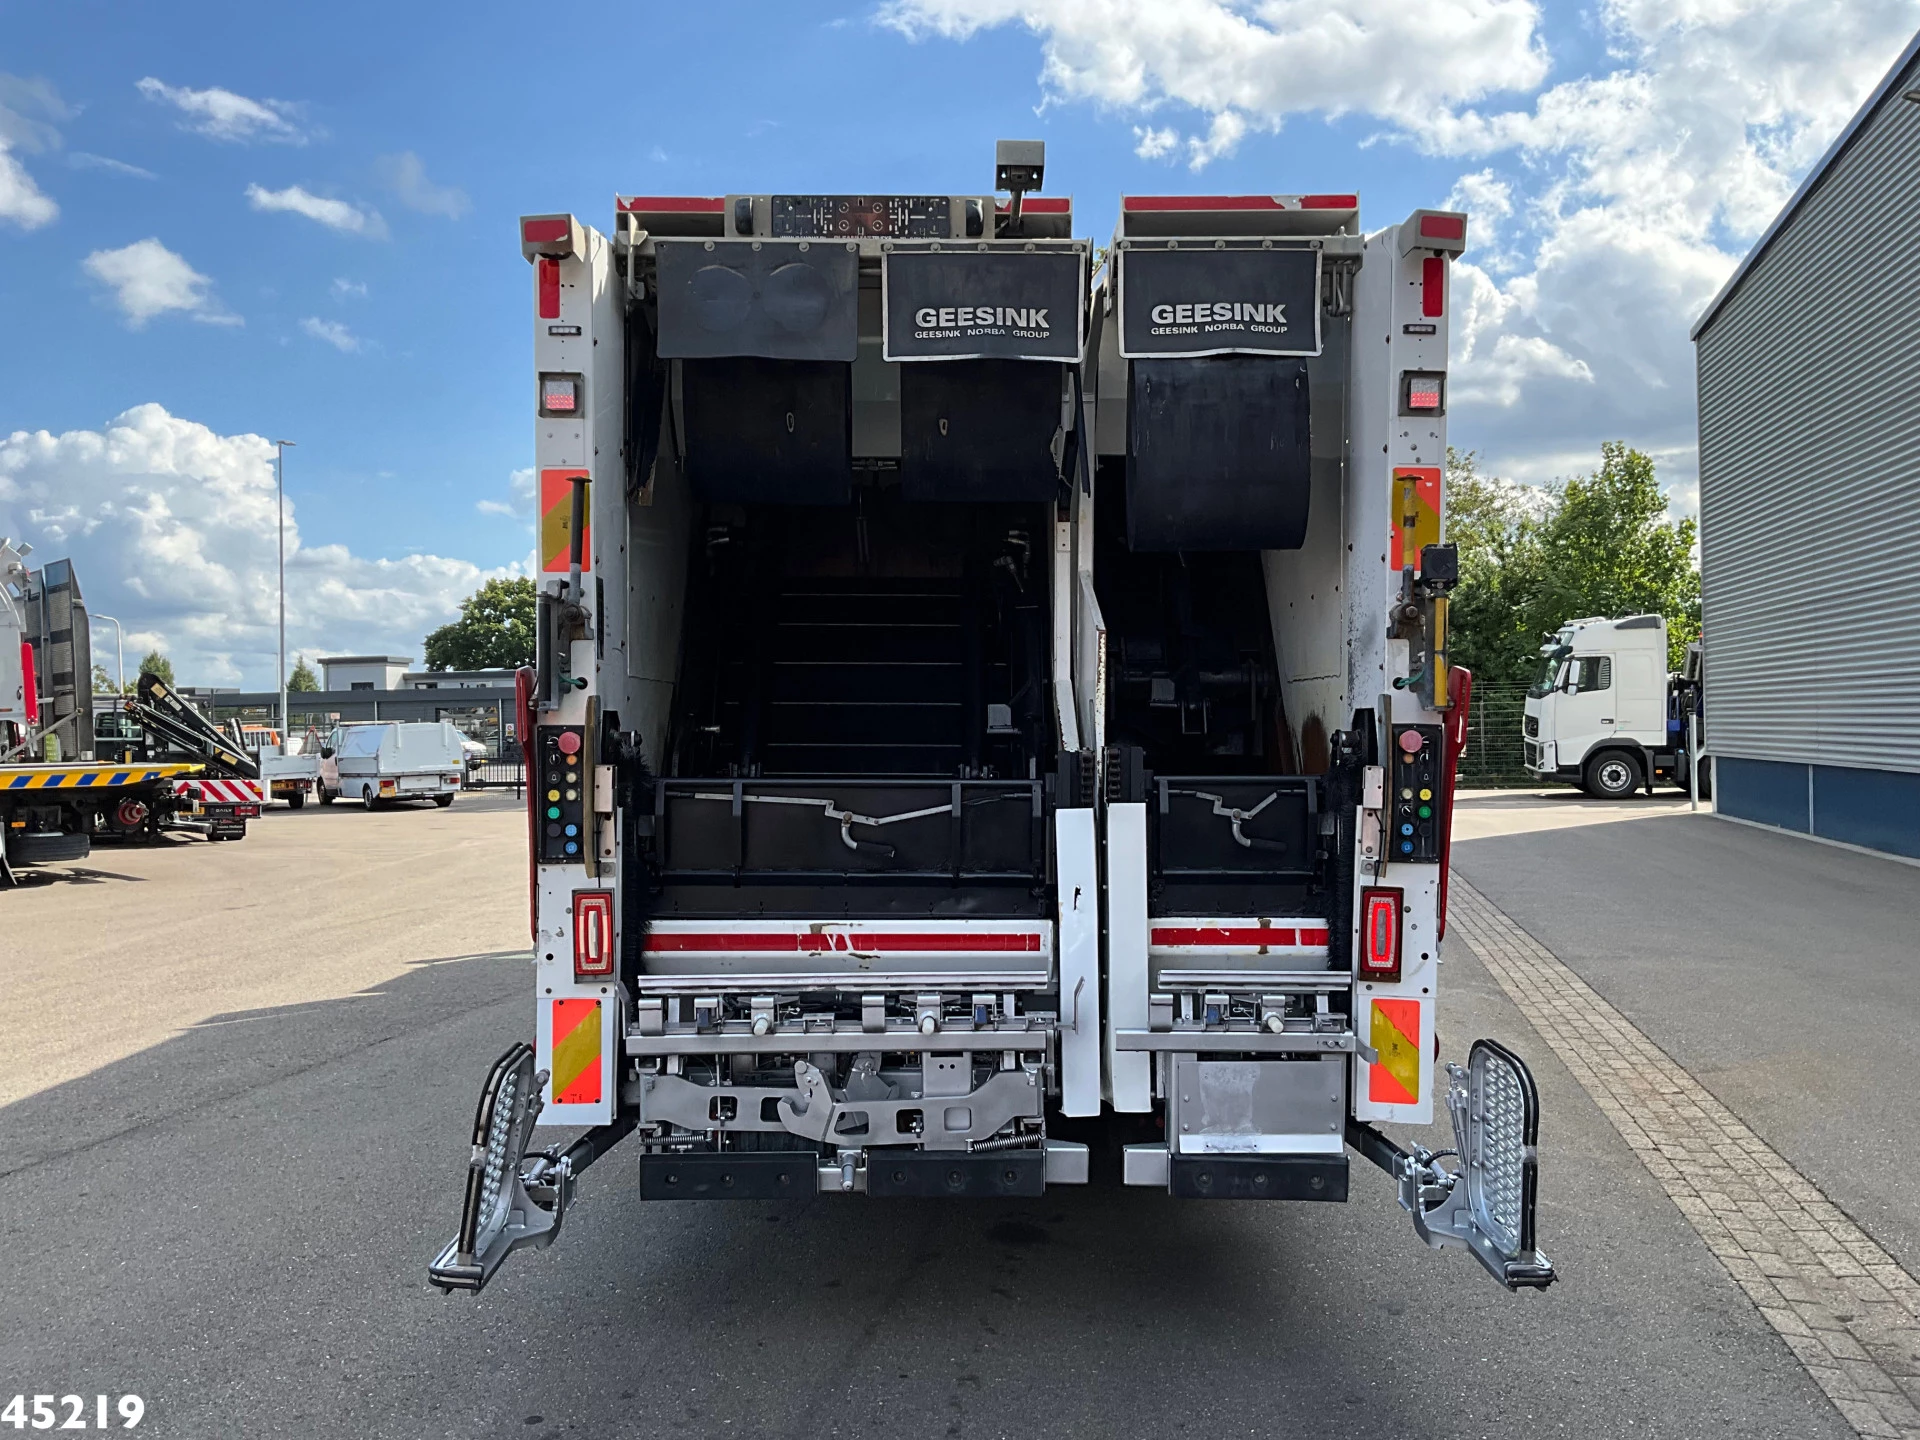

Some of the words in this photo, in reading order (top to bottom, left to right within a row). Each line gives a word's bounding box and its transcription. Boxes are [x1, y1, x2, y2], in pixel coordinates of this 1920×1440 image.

[915, 307, 1050, 328] GEESINK
[1151, 302, 1287, 324] GEESINK
[914, 329, 961, 339] GEESINK
[967, 328, 1006, 336] NORBA
[1012, 329, 1050, 339] GROUP
[1151, 325, 1198, 335] GEESINK
[1204, 323, 1245, 332] NORBA
[1250, 324, 1288, 334] GROUP
